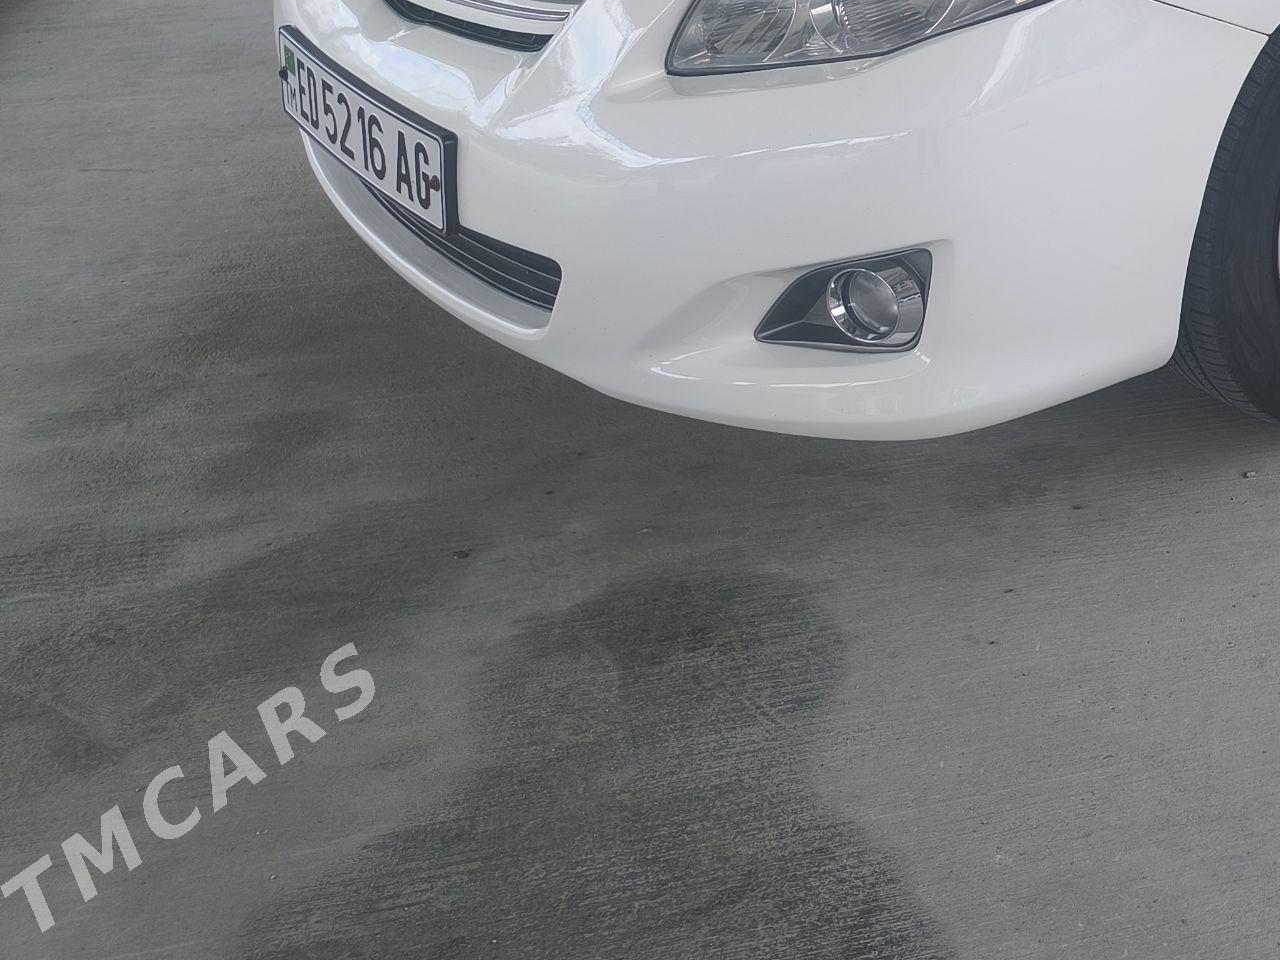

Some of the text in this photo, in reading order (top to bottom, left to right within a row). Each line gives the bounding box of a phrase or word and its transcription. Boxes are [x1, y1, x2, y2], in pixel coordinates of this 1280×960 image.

[297, 57, 320, 130] ED
[321, 77, 387, 181] 5216
[396, 130, 431, 210] AG
